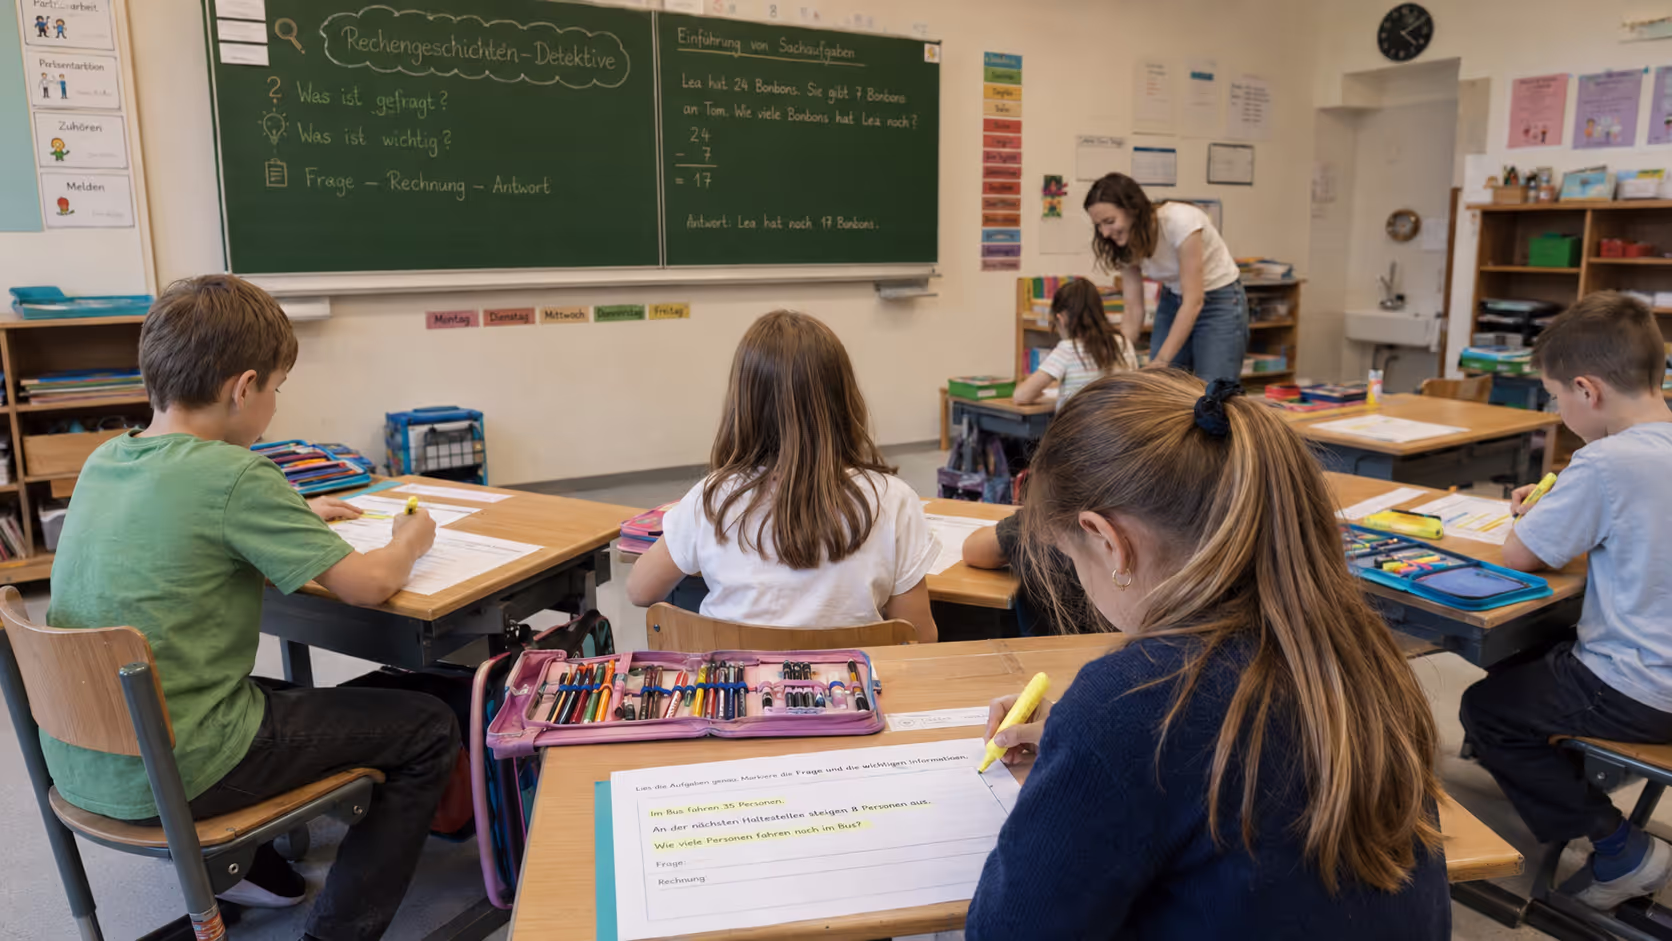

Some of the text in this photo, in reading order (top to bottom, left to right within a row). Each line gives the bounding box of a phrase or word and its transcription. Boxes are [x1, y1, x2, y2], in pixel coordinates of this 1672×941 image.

[341, 26, 616, 70] Rechengeschichten-Detektive
[677, 27, 856, 65] Einführung von Sachaufgaben
[297, 81, 330, 104] Was
[341, 86, 362, 105] ist
[682, 72, 702, 88] Lea
[708, 74, 728, 90] hat
[734, 77, 748, 91] 24
[755, 78, 800, 96] Bonbons.
[828, 84, 849, 104] gibt
[856, 86, 862, 100] 7
[683, 105, 698, 115] an
[704, 101, 729, 116] Tom.
[734, 103, 752, 118] Wie
[758, 105, 781, 120] viele
[787, 107, 829, 123] Bonbons
[835, 110, 854, 125] hat
[862, 111, 881, 126] Lea
[58, 120, 103, 132] Zuhören
[297, 122, 331, 144] Was
[345, 126, 366, 145] ist
[690, 126, 711, 142] 24
[702, 146, 711, 162] 7
[66, 182, 105, 193] Melden
[305, 167, 355, 197] Frage
[387, 170, 465, 201] Rechnung
[492, 175, 550, 194] Antwort
[693, 172, 712, 189] 17
[738, 215, 756, 229] Lea
[764, 213, 783, 229] hat
[789, 215, 812, 229] noch
[821, 216, 832, 228] 17
[434, 314, 471, 327] Montag
[489, 311, 529, 324] Dienstag
[544, 306, 585, 320] Mittwoch
[654, 304, 684, 318] Freitag
[669, 779, 710, 789] Aufgaben
[741, 773, 778, 782] Markiere
[796, 768, 823, 776] Frage
[862, 760, 907, 769] wichtigen
[651, 810, 663, 818] Im
[666, 808, 684, 816] Bus
[687, 804, 720, 814] fahren
[738, 798, 785, 809] Personen.
[652, 826, 667, 834] An
[670, 824, 689, 832] der
[691, 818, 740, 829] nächsten
[809, 807, 848, 818] steigen
[861, 801, 908, 812] Personen
[910, 798, 932, 806] aus.
[654, 820, 861, 850] Wie viele Personen fahren noch im Bus?
[656, 860, 687, 869] Frage:
